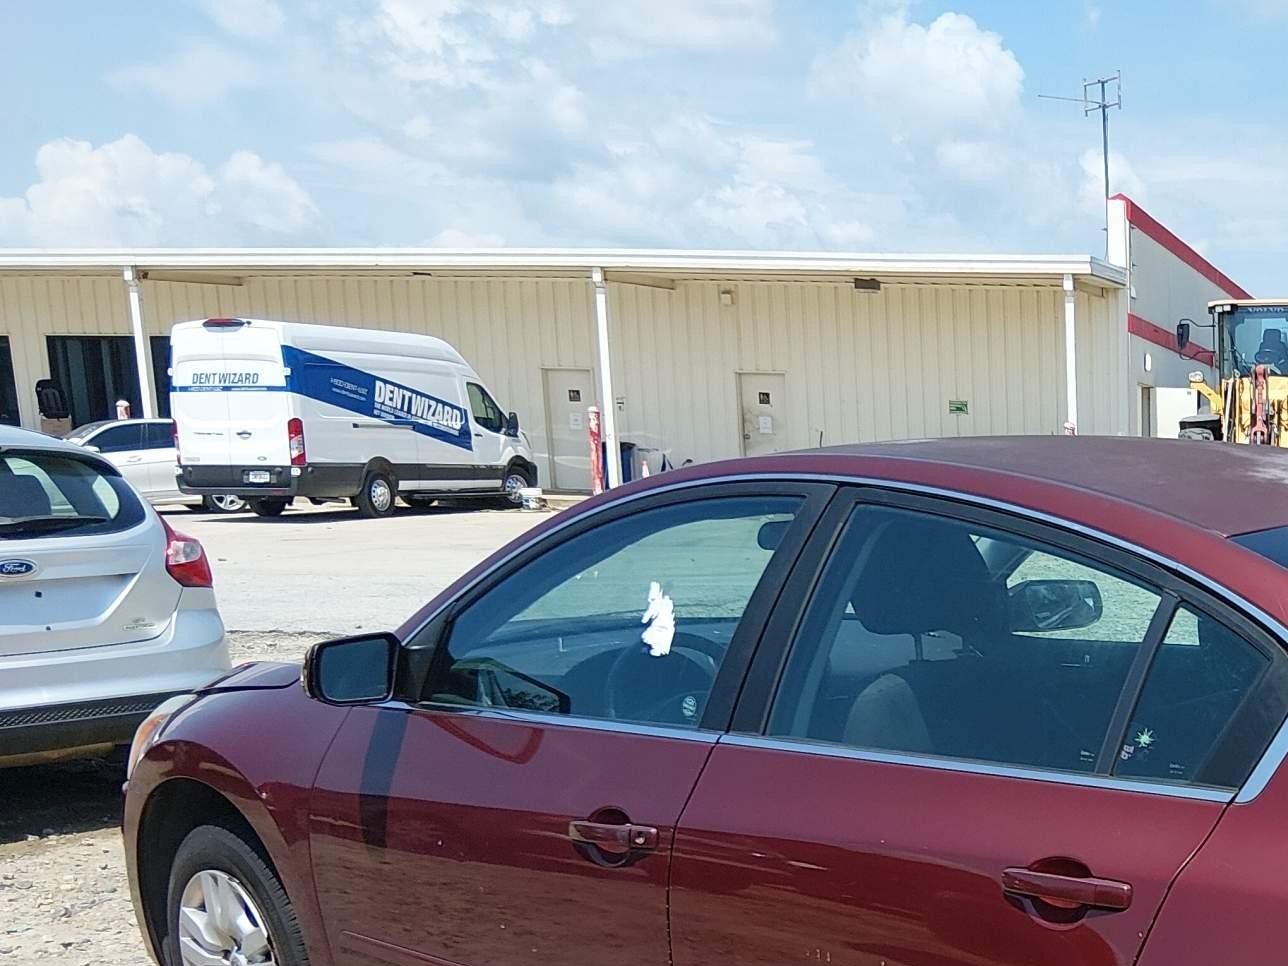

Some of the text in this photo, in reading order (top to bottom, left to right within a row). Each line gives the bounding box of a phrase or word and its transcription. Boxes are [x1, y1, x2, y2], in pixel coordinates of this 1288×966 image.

[192, 372, 259, 385] DENT WIZARD
[374, 380, 412, 413] DENT
[411, 393, 462, 430] WIZARD
[2, 562, 27, 574] Ford
